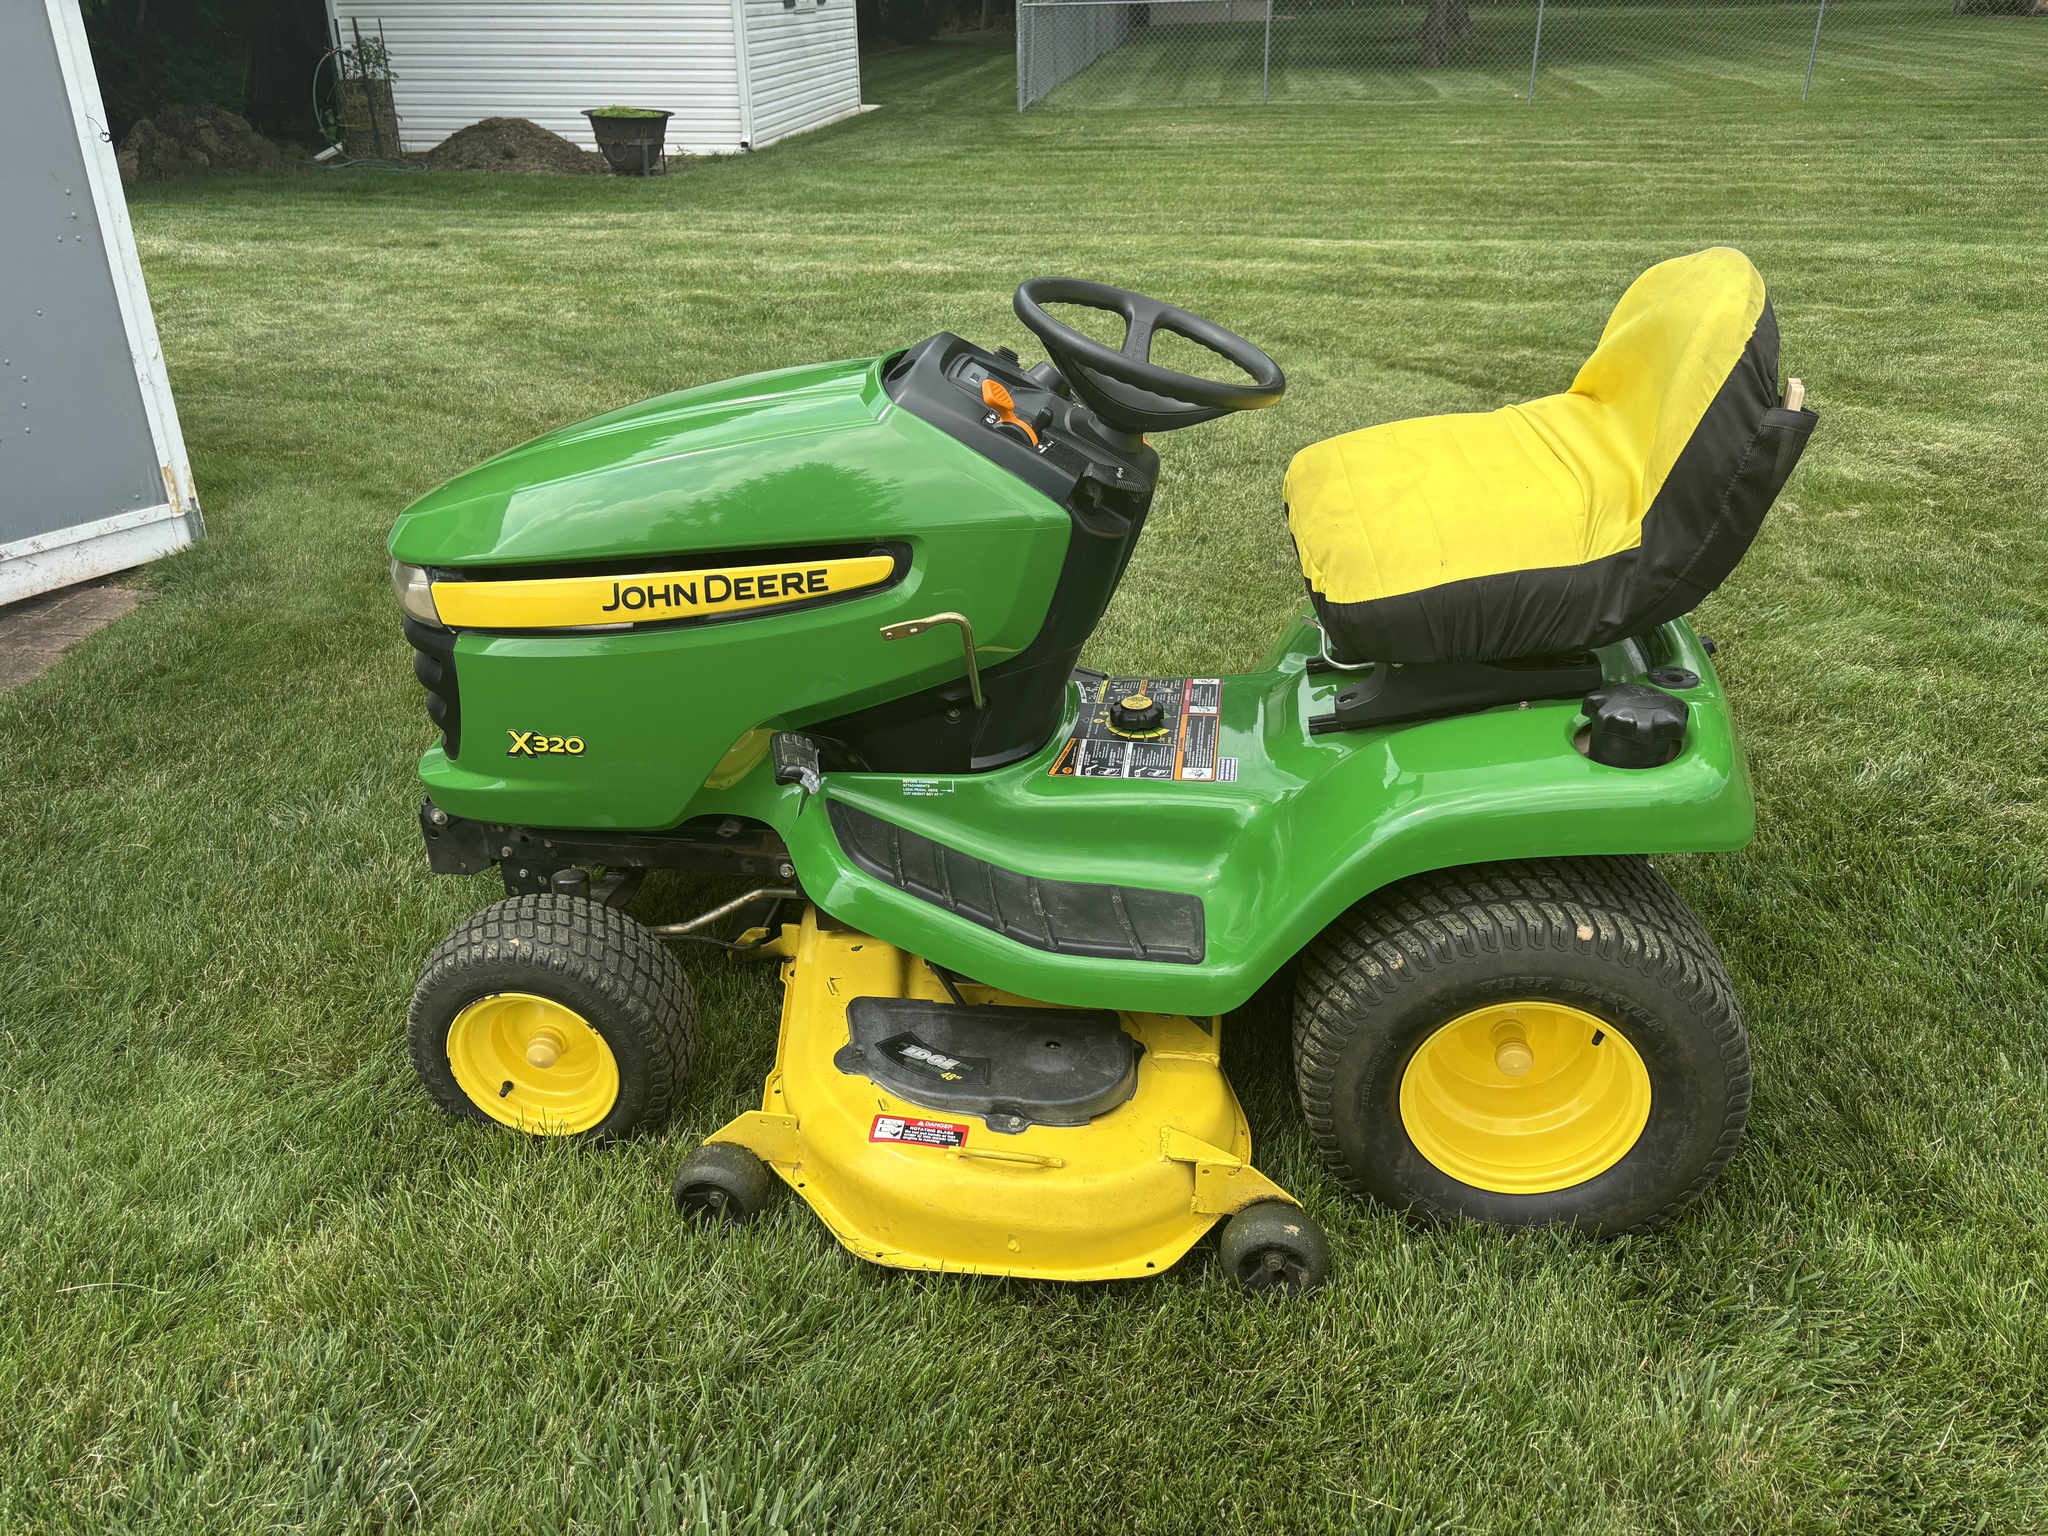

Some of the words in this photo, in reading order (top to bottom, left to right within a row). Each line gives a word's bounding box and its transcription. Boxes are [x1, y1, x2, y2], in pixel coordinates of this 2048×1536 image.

[602, 581, 697, 612] JOHN
[704, 568, 829, 604] DEERE
[506, 729, 587, 759] X320
[1480, 976, 1552, 994] TURF
[1560, 979, 1666, 1034] MASTER
[898, 1044, 960, 1071] EDGE
[925, 1121, 953, 1129] DANGER
